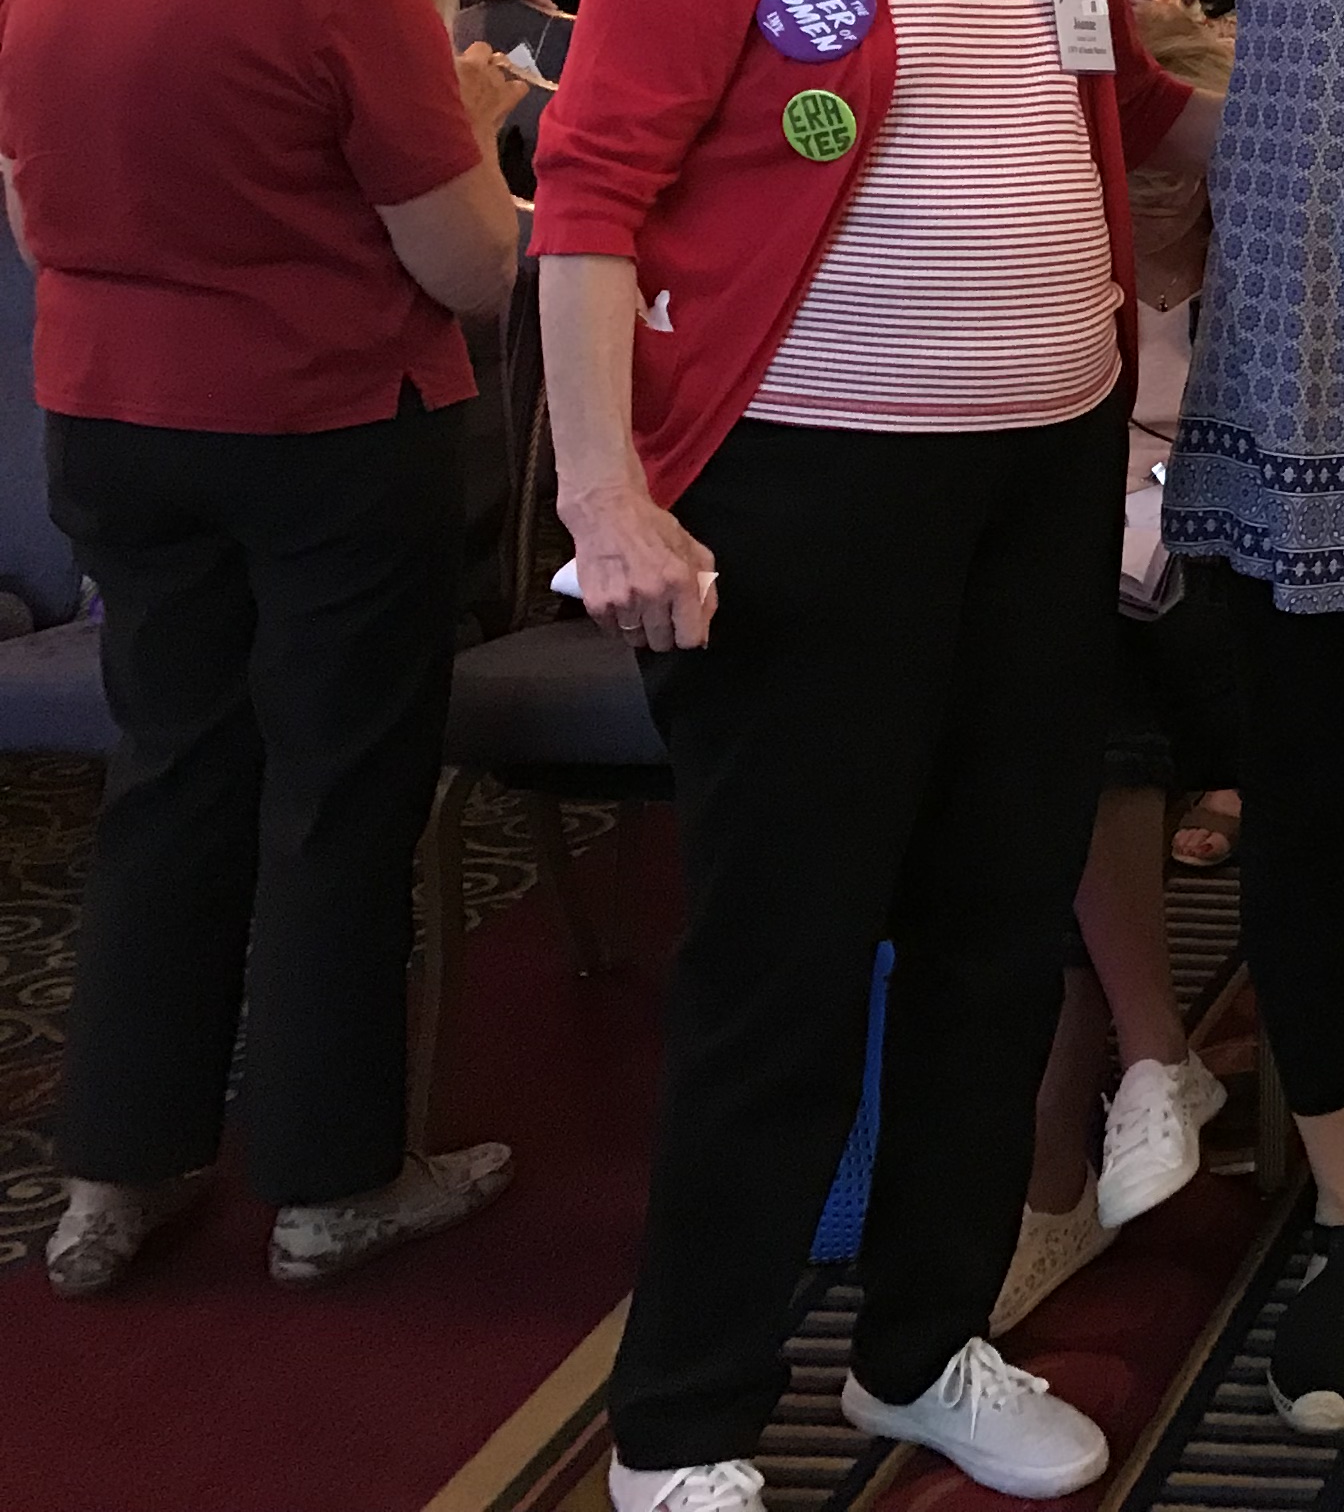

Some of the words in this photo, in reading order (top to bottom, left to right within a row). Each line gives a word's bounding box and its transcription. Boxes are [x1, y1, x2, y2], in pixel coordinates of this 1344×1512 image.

[851, 1, 869, 16] THE
[839, 30, 857, 40] OF
[788, 95, 843, 133] ERA
[794, 126, 850, 157] YES
